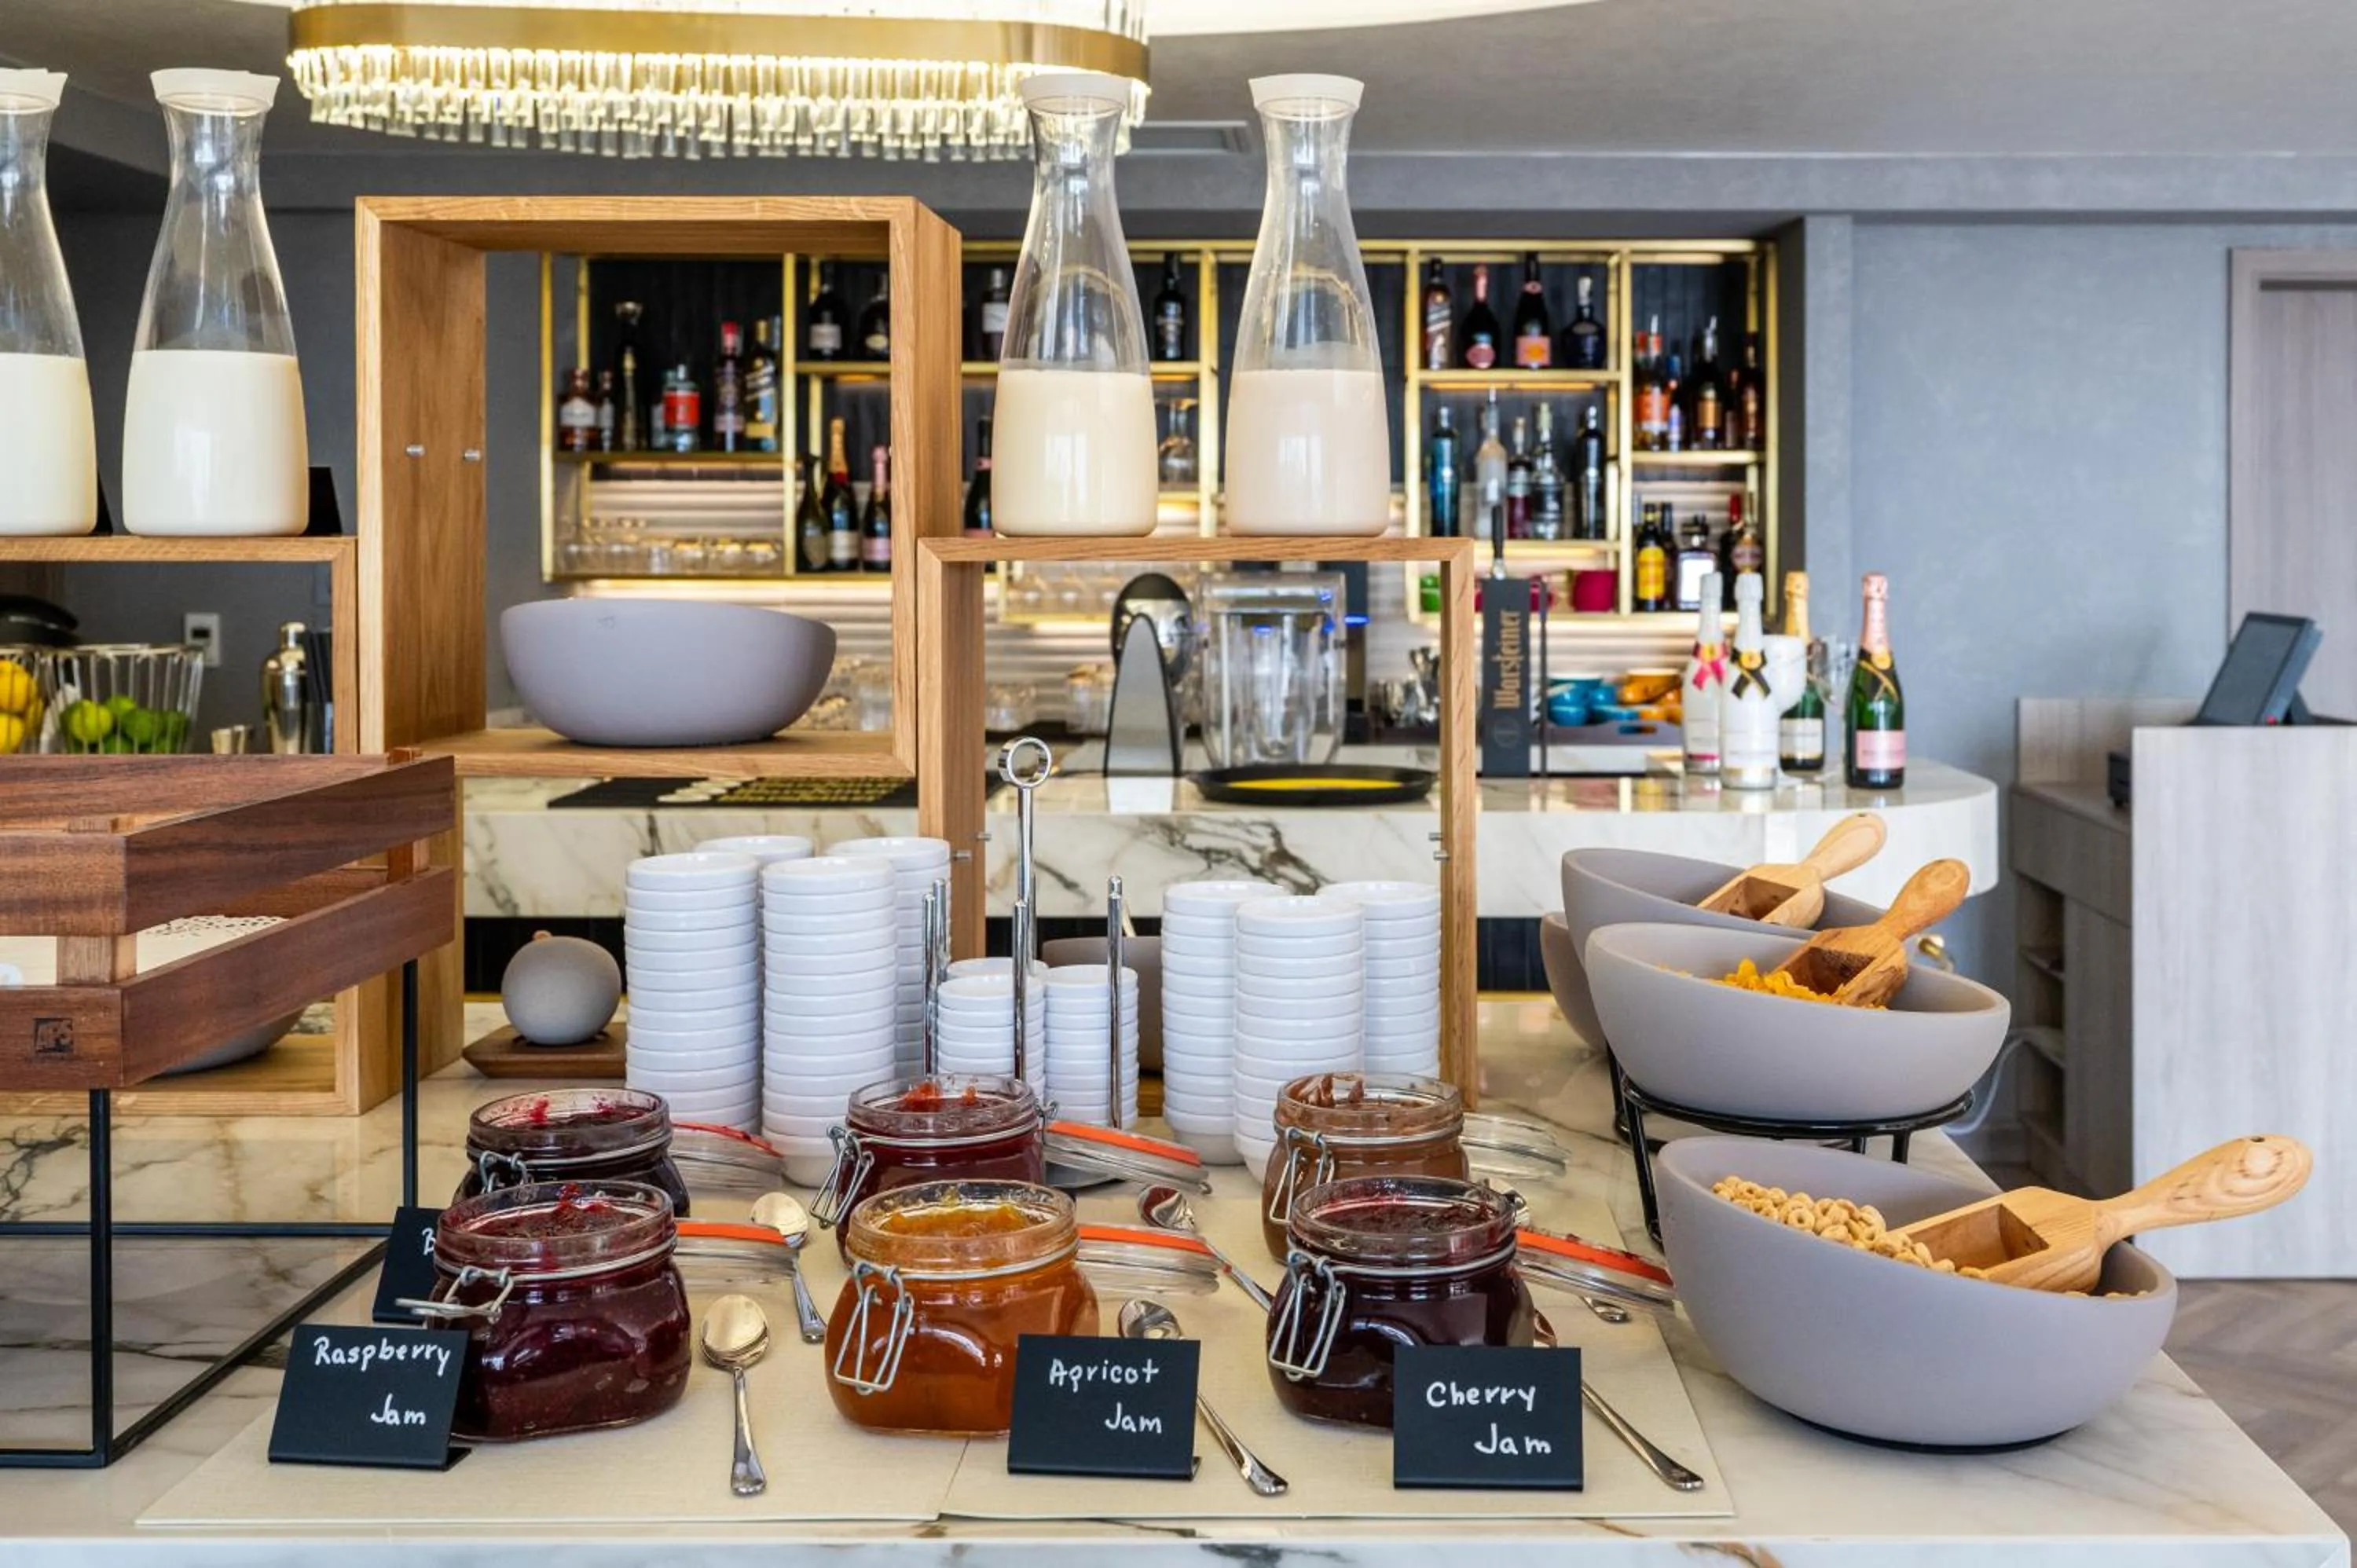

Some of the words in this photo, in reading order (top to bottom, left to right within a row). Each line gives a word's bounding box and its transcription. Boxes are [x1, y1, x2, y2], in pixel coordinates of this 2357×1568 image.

[313, 1335, 451, 1377] Raspberry
[1049, 1358, 1160, 1393] Apricot
[370, 1393, 426, 1426] Jam
[1426, 1381, 1536, 1412] Cherry
[1105, 1401, 1162, 1434] Jam
[1473, 1423, 1552, 1455] Jam
